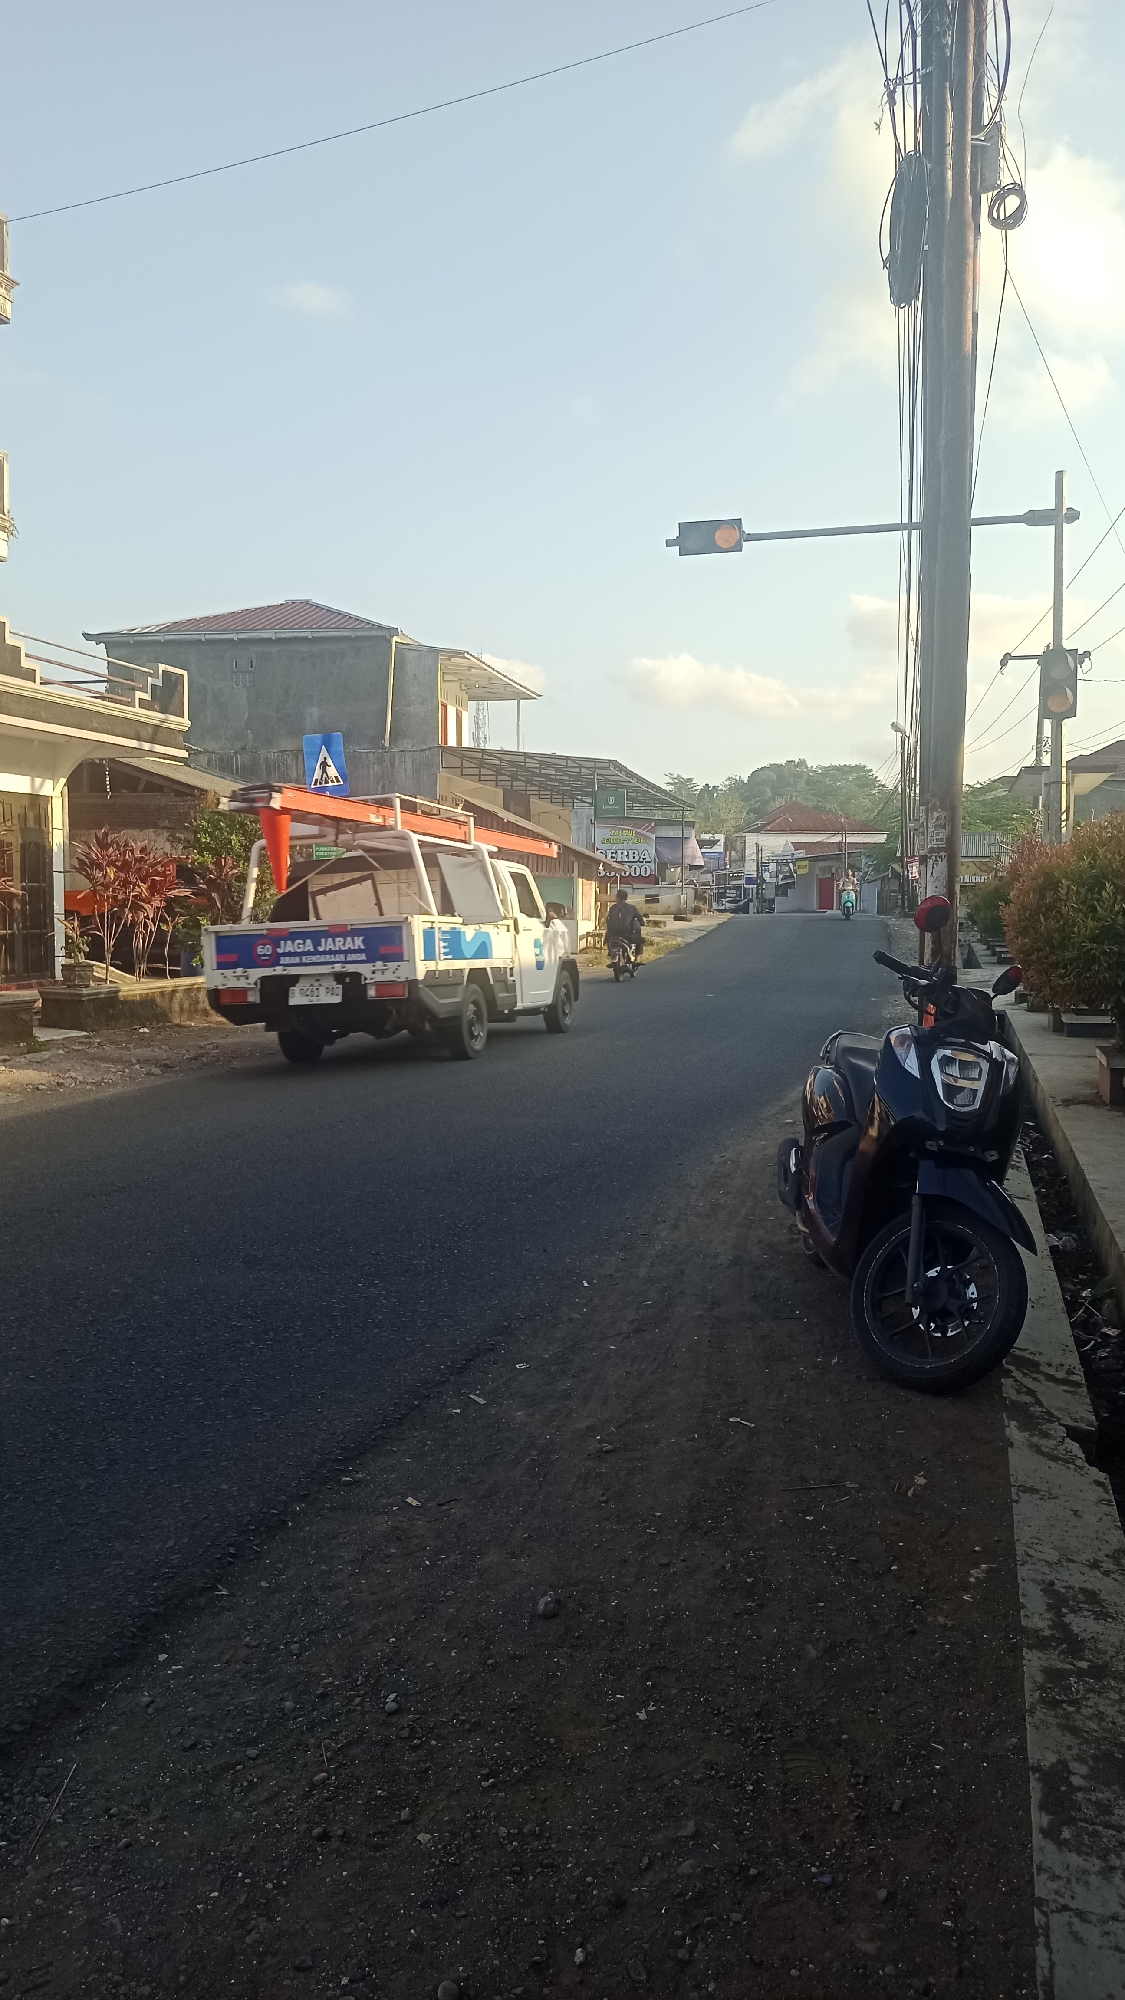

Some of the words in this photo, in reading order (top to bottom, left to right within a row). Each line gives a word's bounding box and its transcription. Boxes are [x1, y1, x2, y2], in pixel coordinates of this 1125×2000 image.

[257, 944, 272, 955] 60
[276, 939, 314, 953] JAGA
[317, 937, 365, 951] JARAK
[346, 953, 366, 962] ANDA
